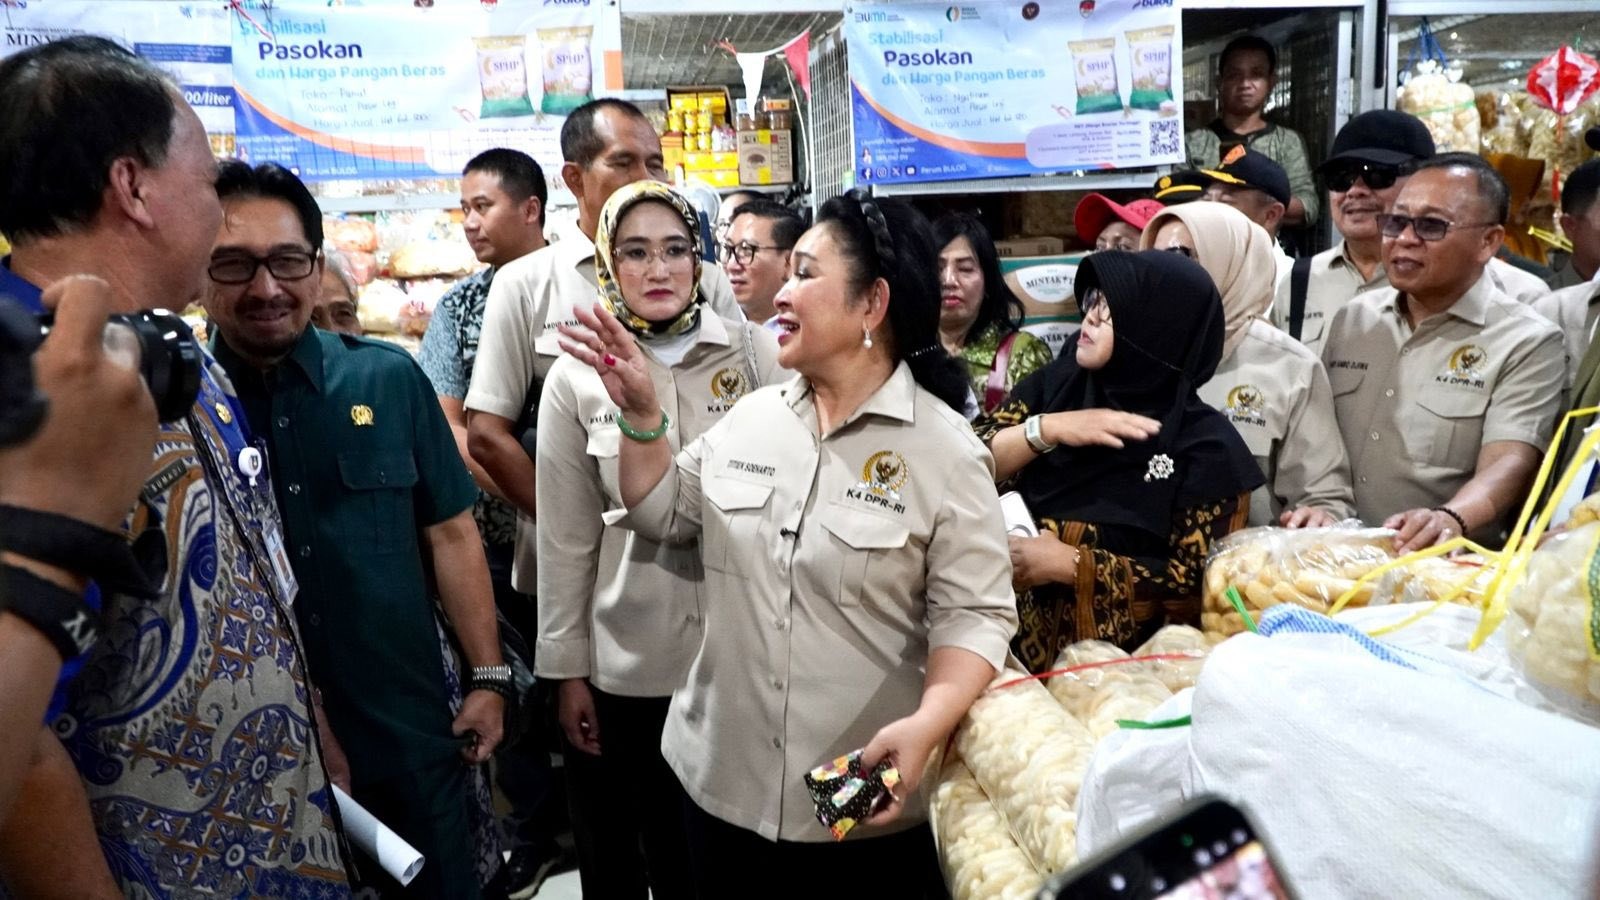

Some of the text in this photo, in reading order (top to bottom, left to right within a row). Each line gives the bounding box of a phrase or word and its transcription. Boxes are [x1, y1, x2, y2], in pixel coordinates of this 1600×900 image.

[868, 29, 943, 45] Stabilisasi
[258, 39, 362, 60] Pasokan
[884, 48, 972, 67] Pasokan
[256, 63, 446, 82] dan Harga Pangan Beras
[882, 68, 1045, 86] dan Harga Pangan Beras
[184, 91, 231, 105] 00/liter
[1026, 275, 1062, 289] MINYAK
[847, 488, 905, 514] K4 DPR-RI
